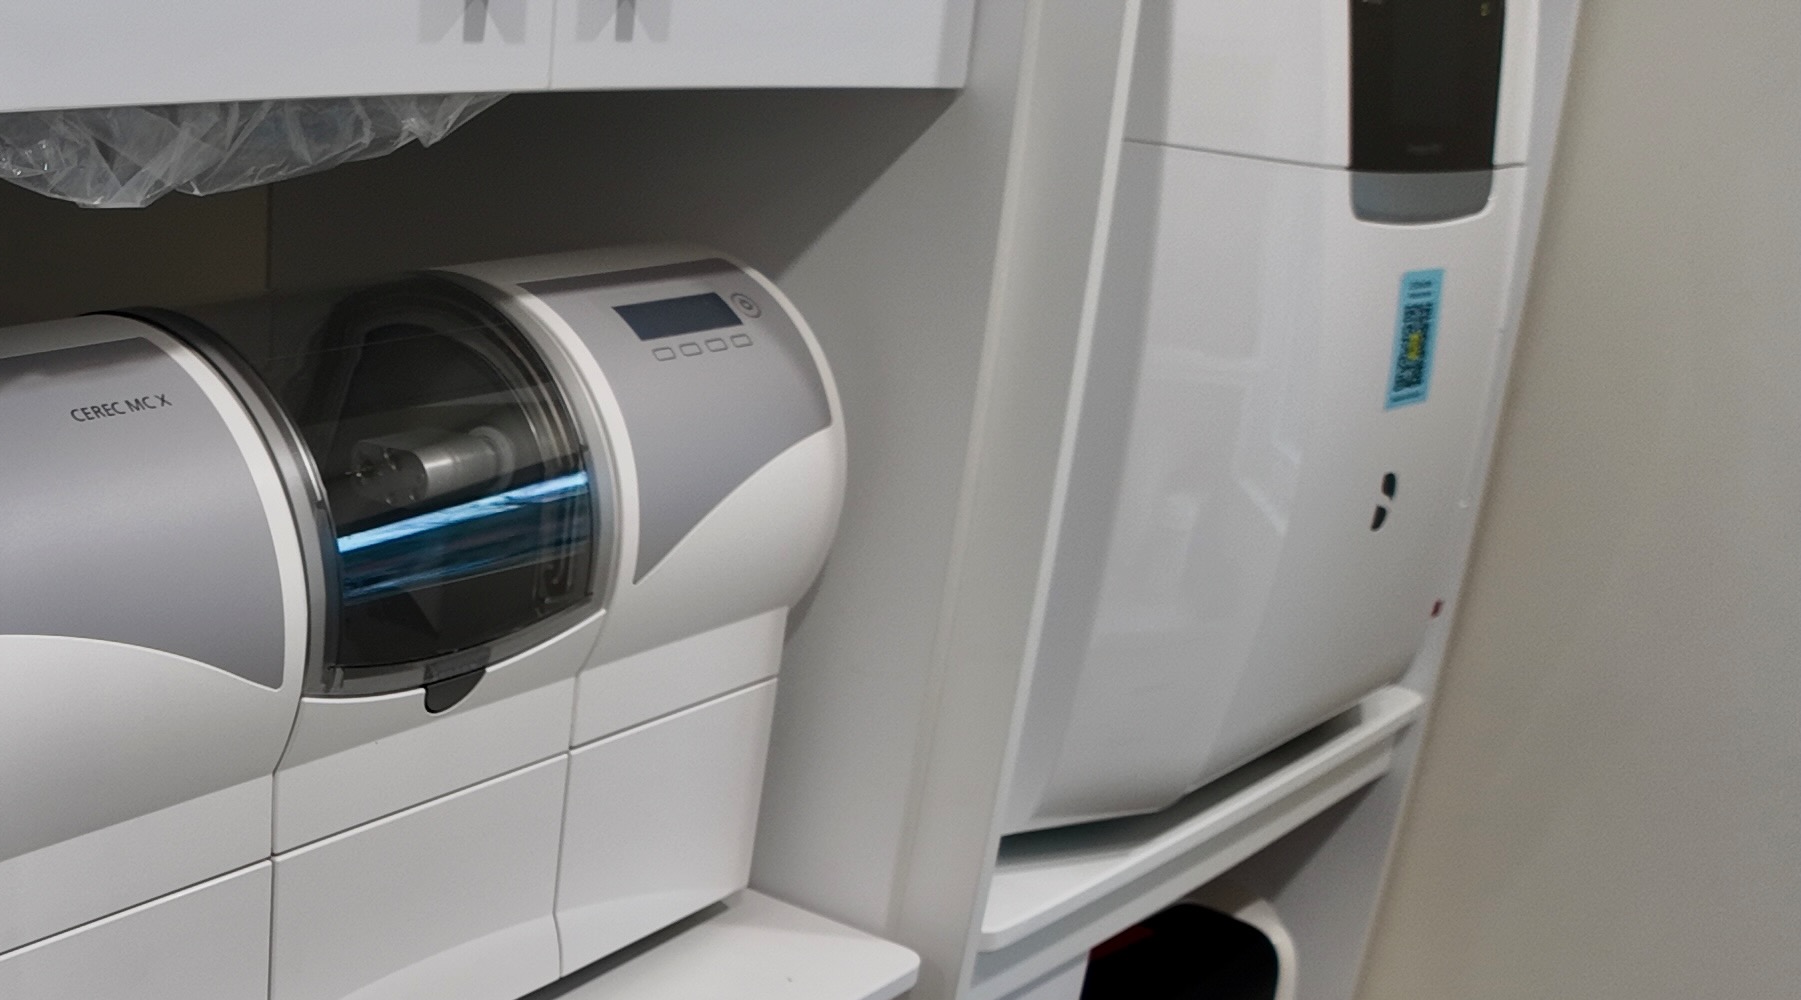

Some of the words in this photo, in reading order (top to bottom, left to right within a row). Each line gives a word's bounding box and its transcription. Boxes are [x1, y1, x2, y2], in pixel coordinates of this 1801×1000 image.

[70, 401, 126, 422] CEREC
[125, 396, 157, 412] MC
[154, 393, 173, 407] X
